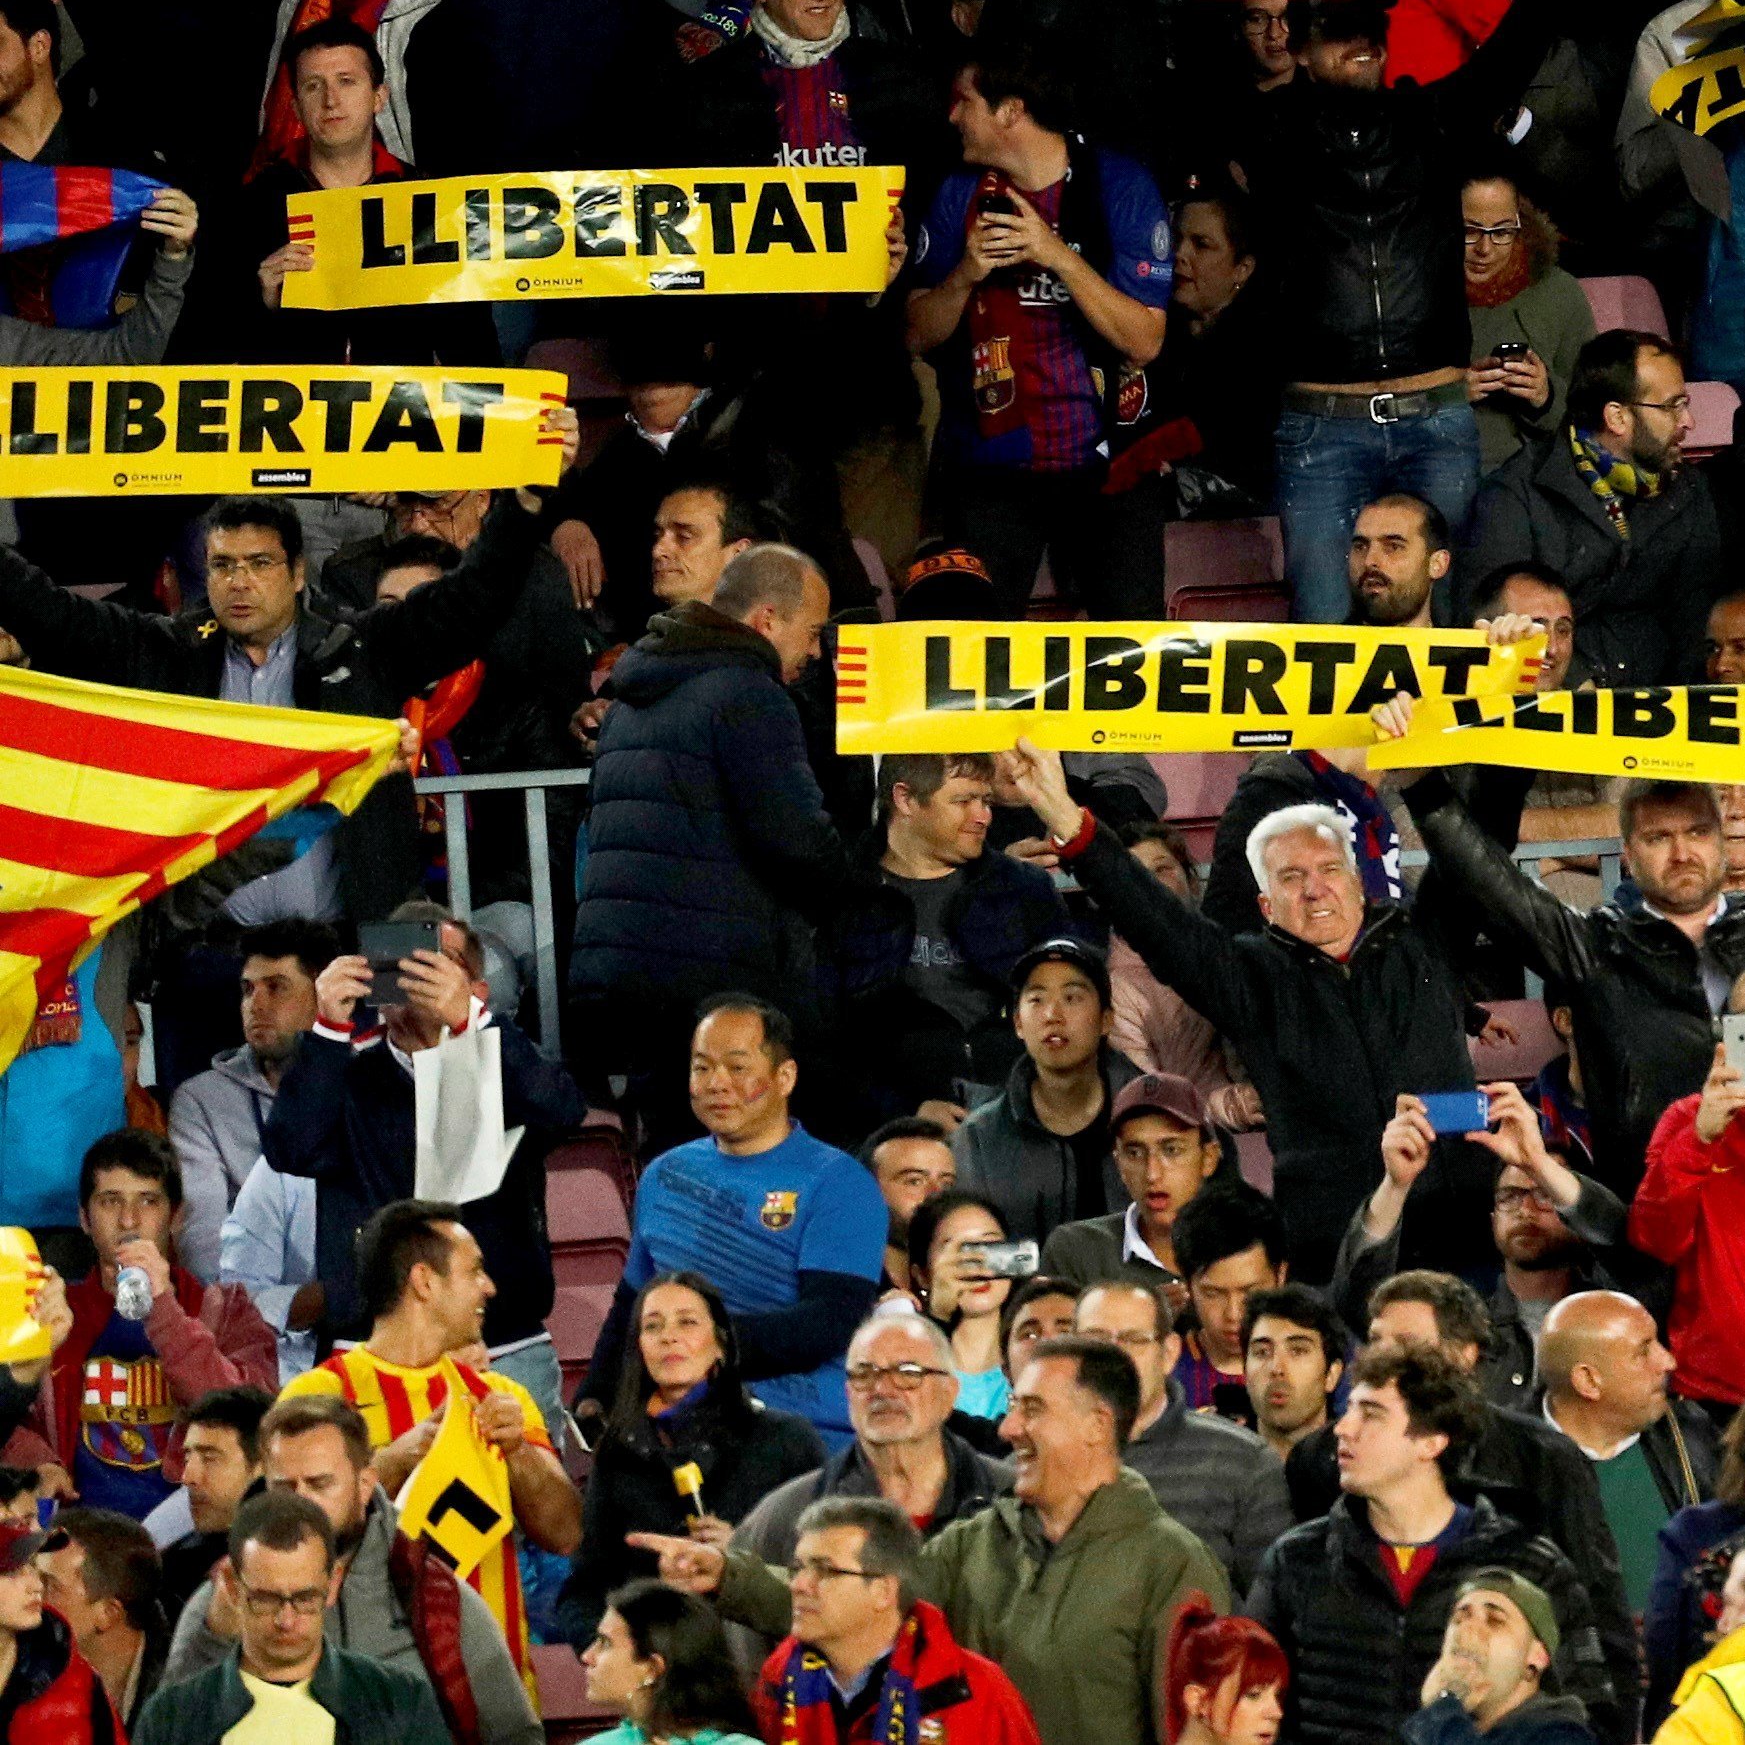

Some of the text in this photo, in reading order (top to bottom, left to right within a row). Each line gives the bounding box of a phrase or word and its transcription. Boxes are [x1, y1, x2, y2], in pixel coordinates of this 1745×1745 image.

[360, 182, 857, 270] LLIBERTAT
[0, 380, 505, 455] LIBERTAT
[257, 472, 306, 482] assemblea
[925, 635, 1491, 716] LLIBERTAT
